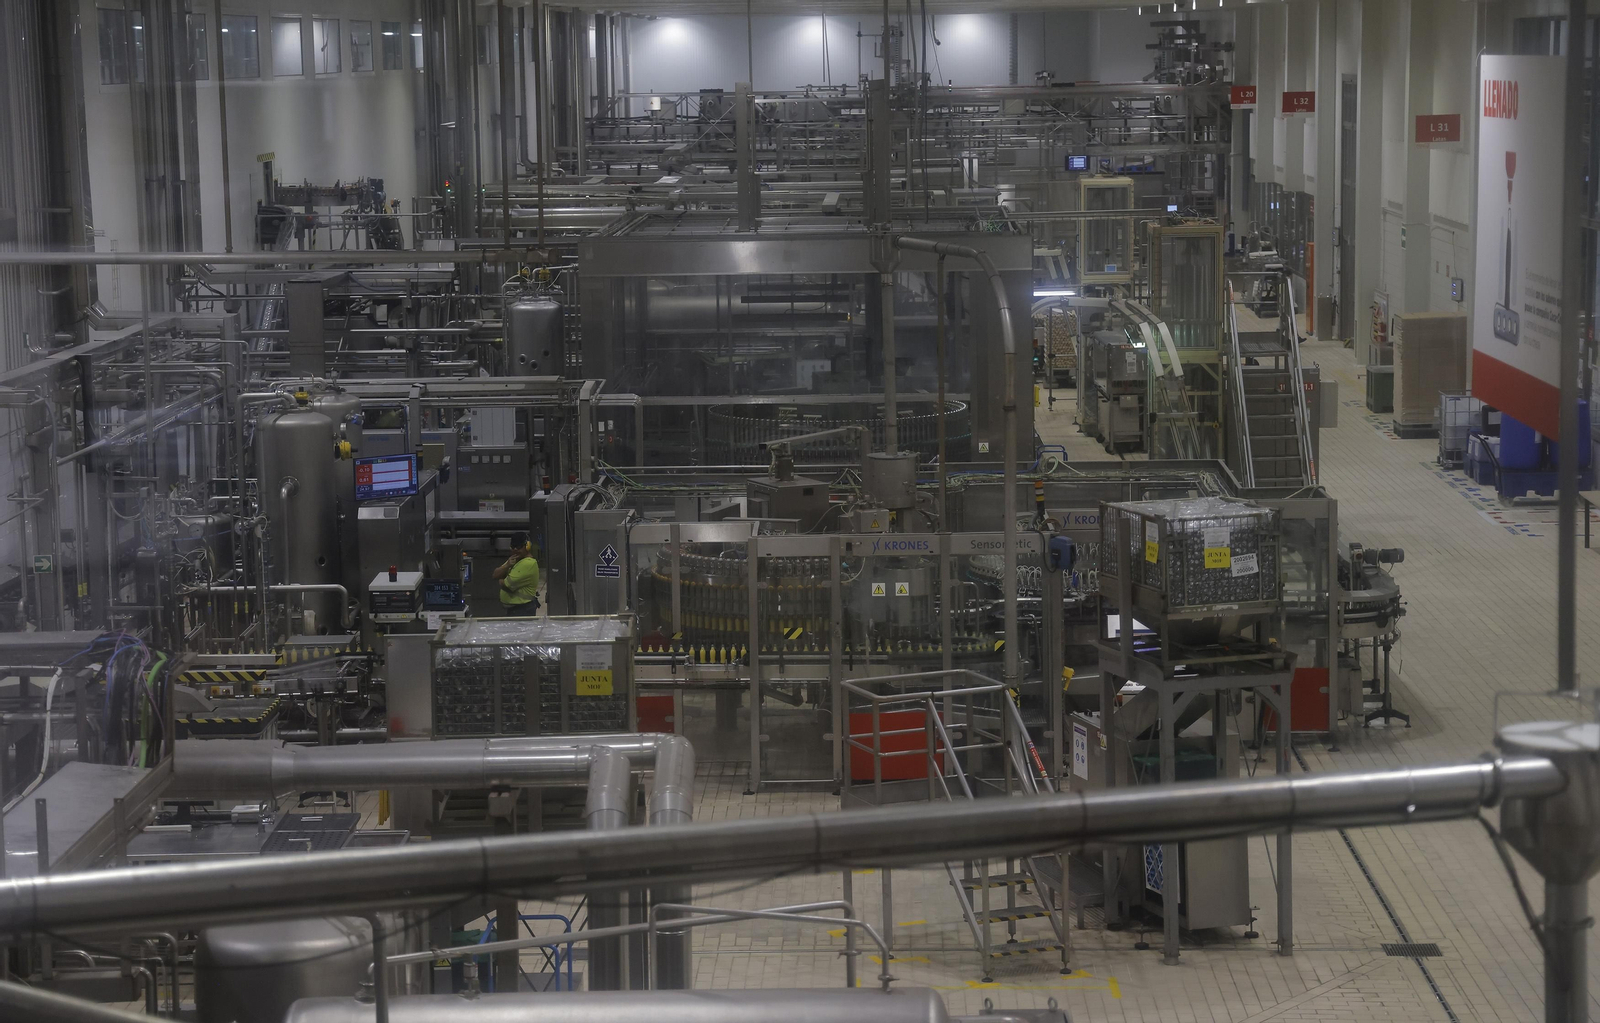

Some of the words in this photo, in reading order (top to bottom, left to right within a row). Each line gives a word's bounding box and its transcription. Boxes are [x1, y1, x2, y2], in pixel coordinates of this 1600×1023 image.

[1484, 80, 1518, 120] LLENADO
[1430, 123, 1435, 131] L
[1438, 123, 1449, 131] 31
[884, 540, 929, 550] KRONES
[970, 539, 1032, 549] Sensotic
